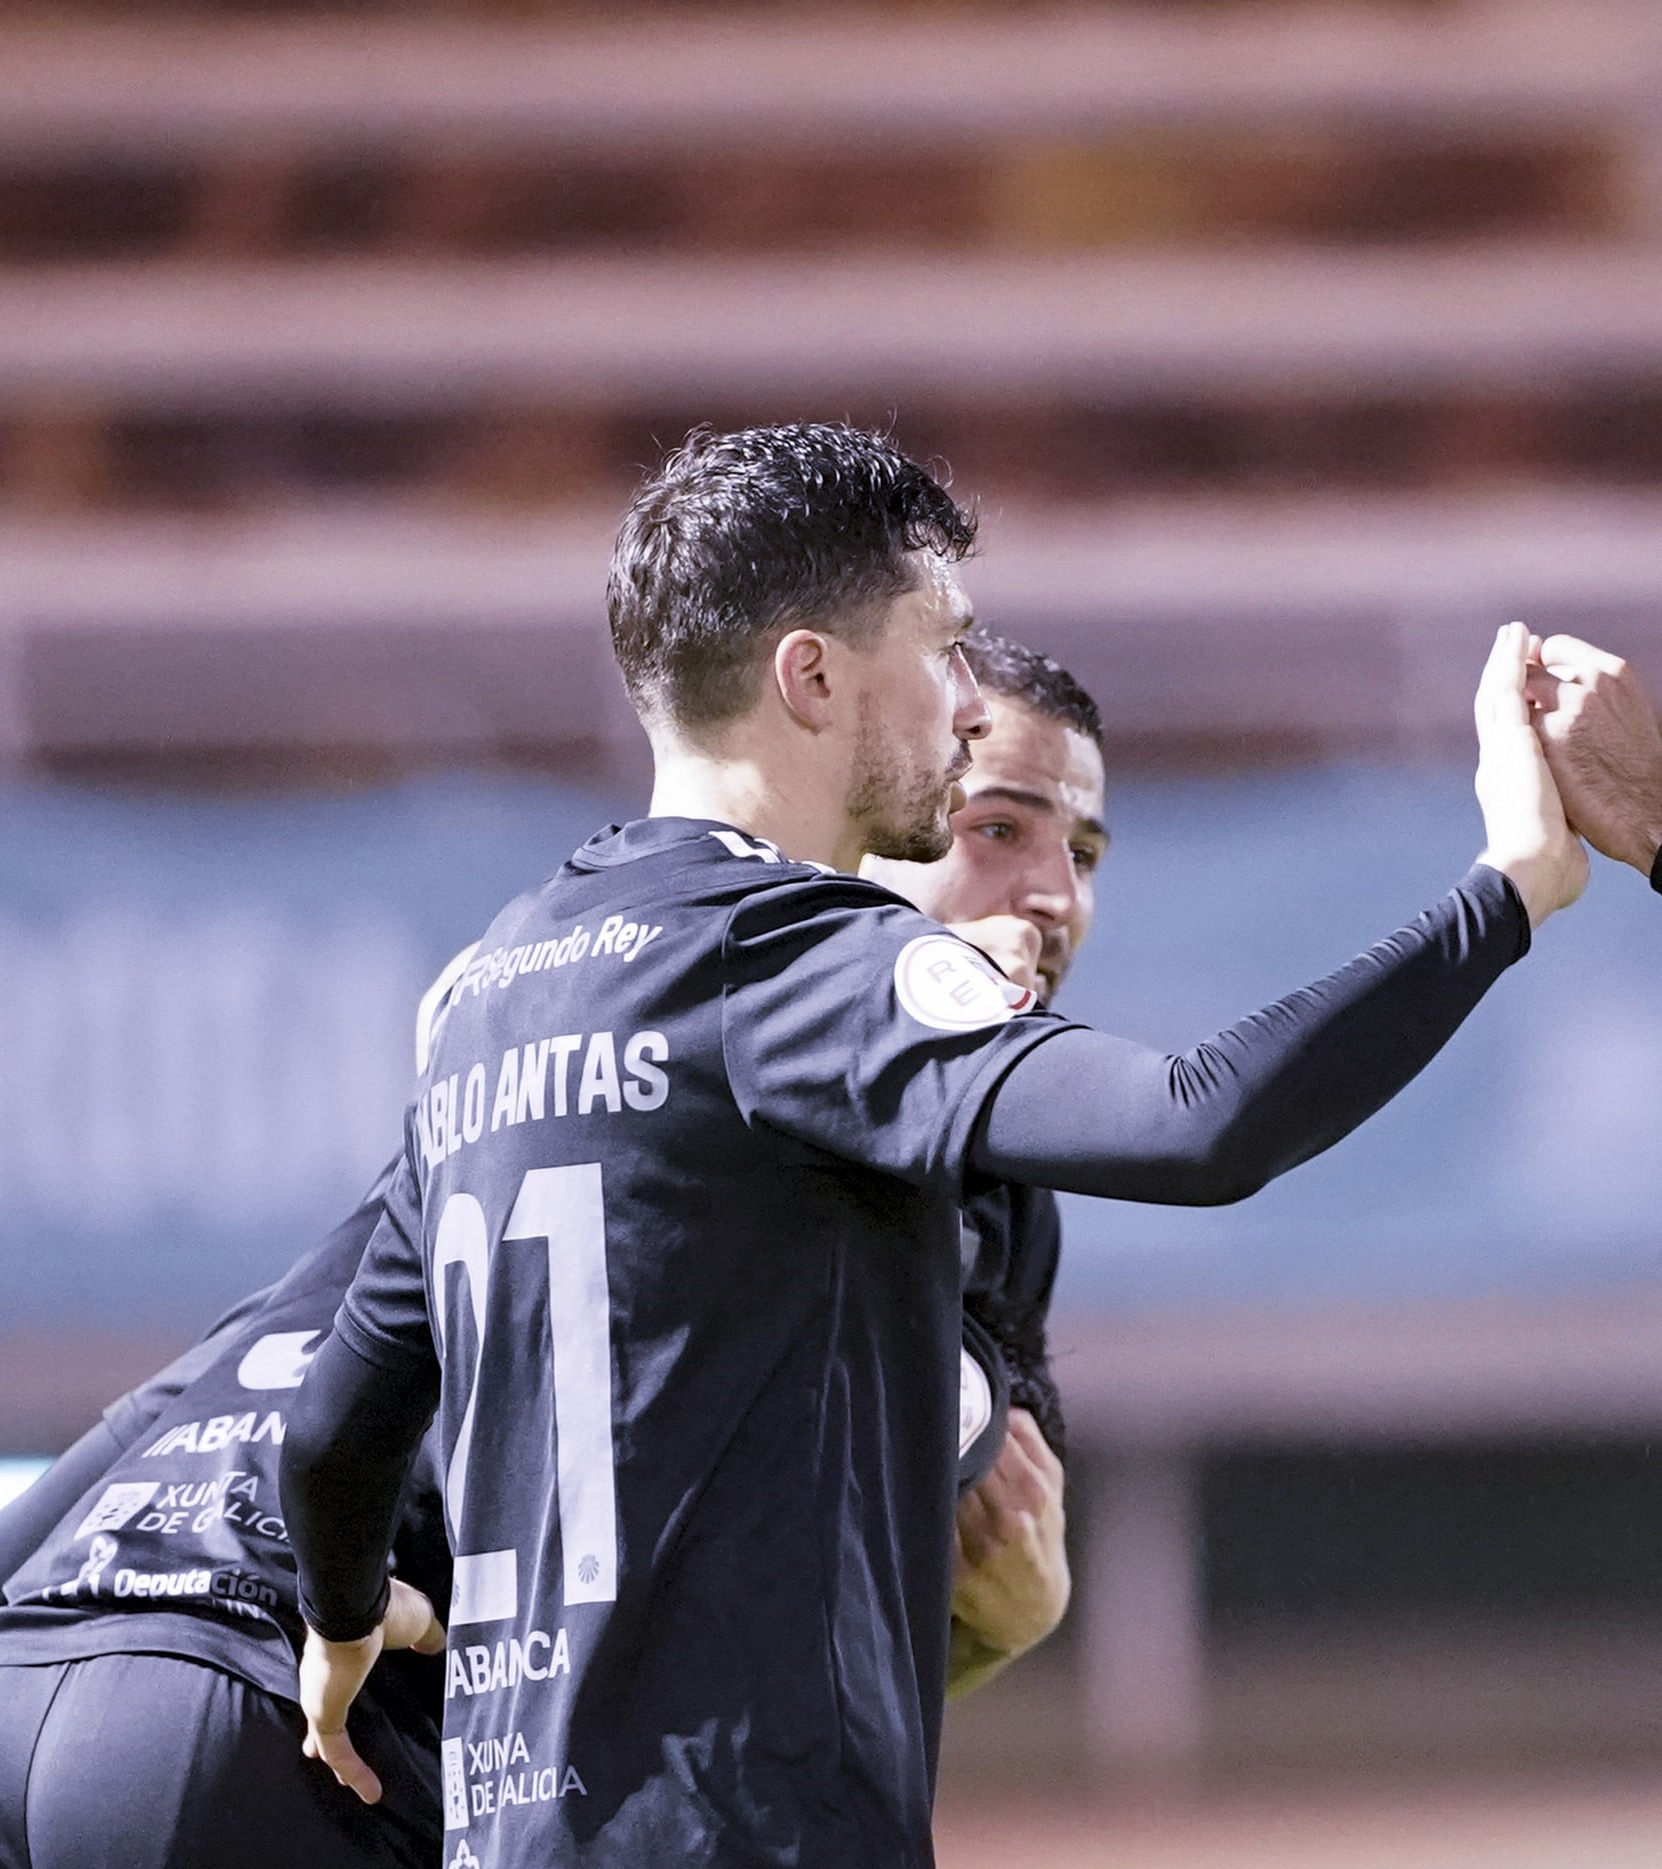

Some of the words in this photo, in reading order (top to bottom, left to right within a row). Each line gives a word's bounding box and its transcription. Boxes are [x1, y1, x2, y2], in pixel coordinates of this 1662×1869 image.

[591, 915, 664, 963] Rey
[415, 1062, 486, 1167] ABLO
[490, 1030, 669, 1133] ANTAS
[433, 1162, 618, 1627] 21
[156, 1471, 259, 1509] XUNTA
[136, 1511, 189, 1534] DE
[114, 1568, 278, 1607] Deputación
[470, 1780, 497, 1817] DE
[501, 1765, 589, 1808] ALICIA
